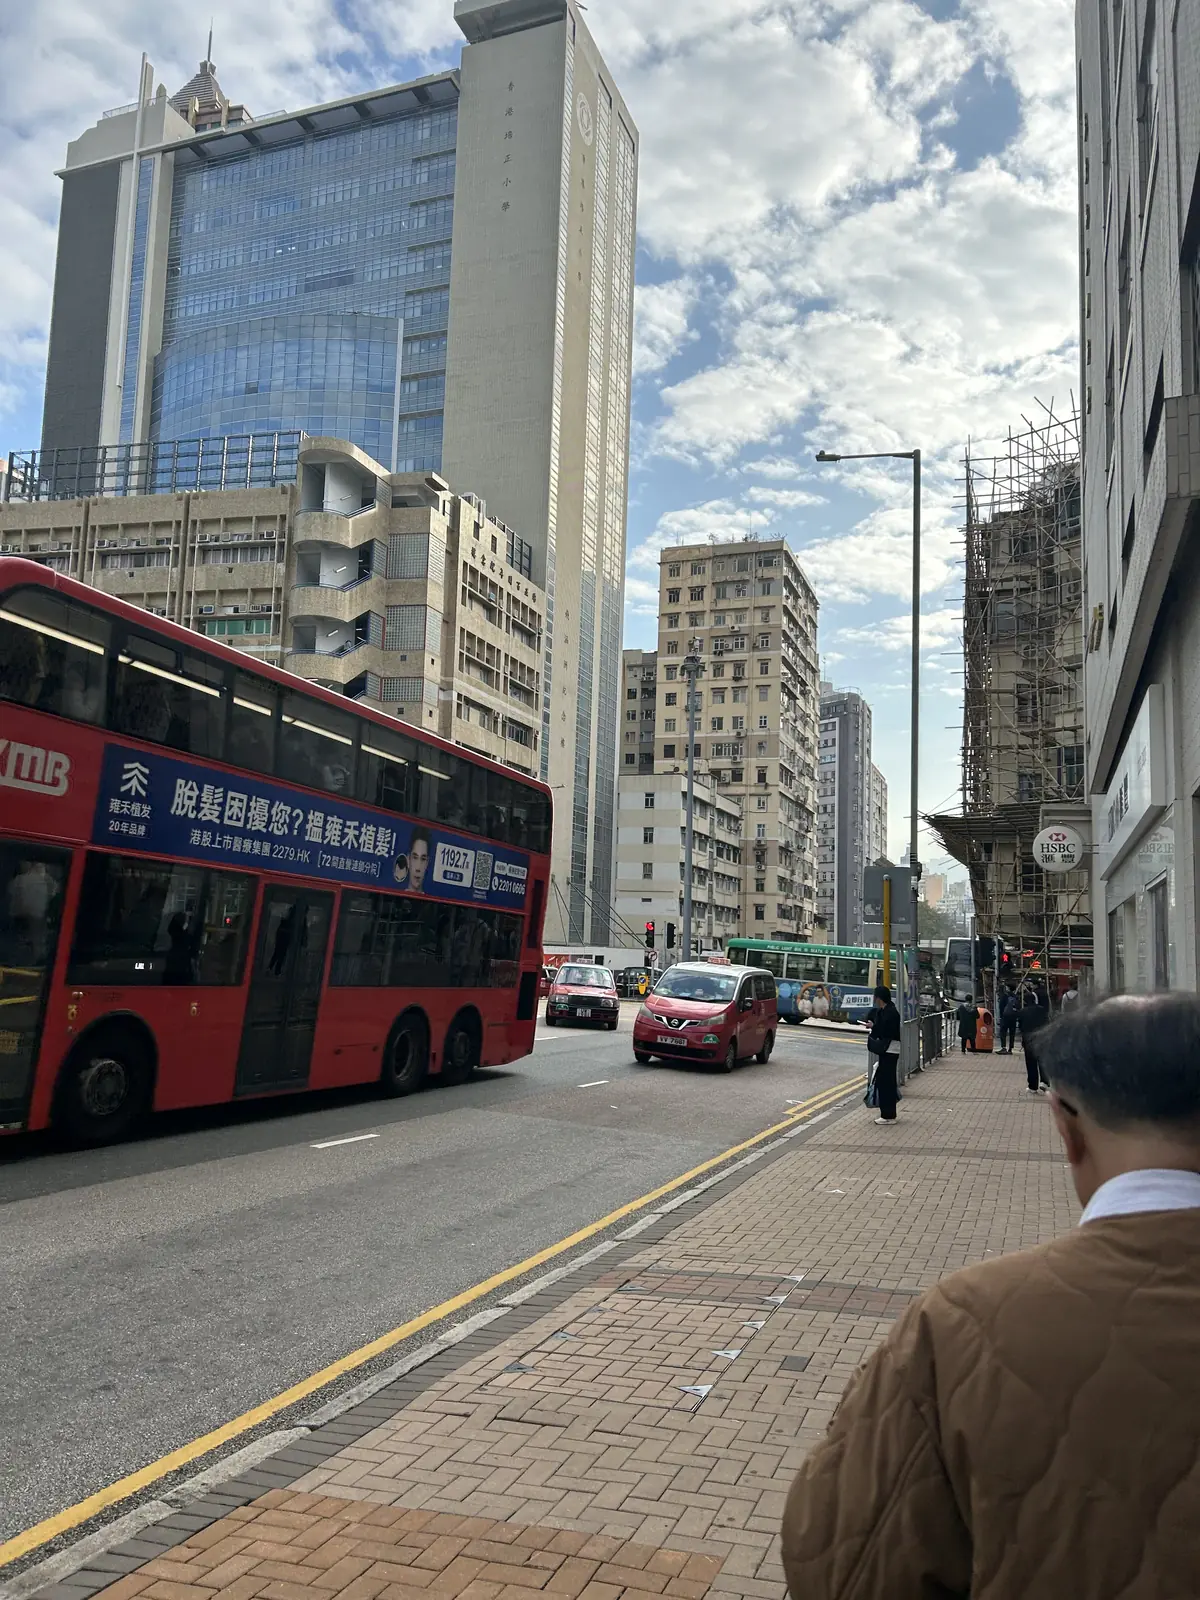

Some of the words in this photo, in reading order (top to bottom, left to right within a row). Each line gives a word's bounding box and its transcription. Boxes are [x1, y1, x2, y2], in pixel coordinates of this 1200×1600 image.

[109, 798, 152, 819] 雍禾植发
[189, 828, 271, 857] 港股上市醫療集團
[271, 845, 310, 864] 2279.HK
[1040, 843, 1076, 854] HSBC
